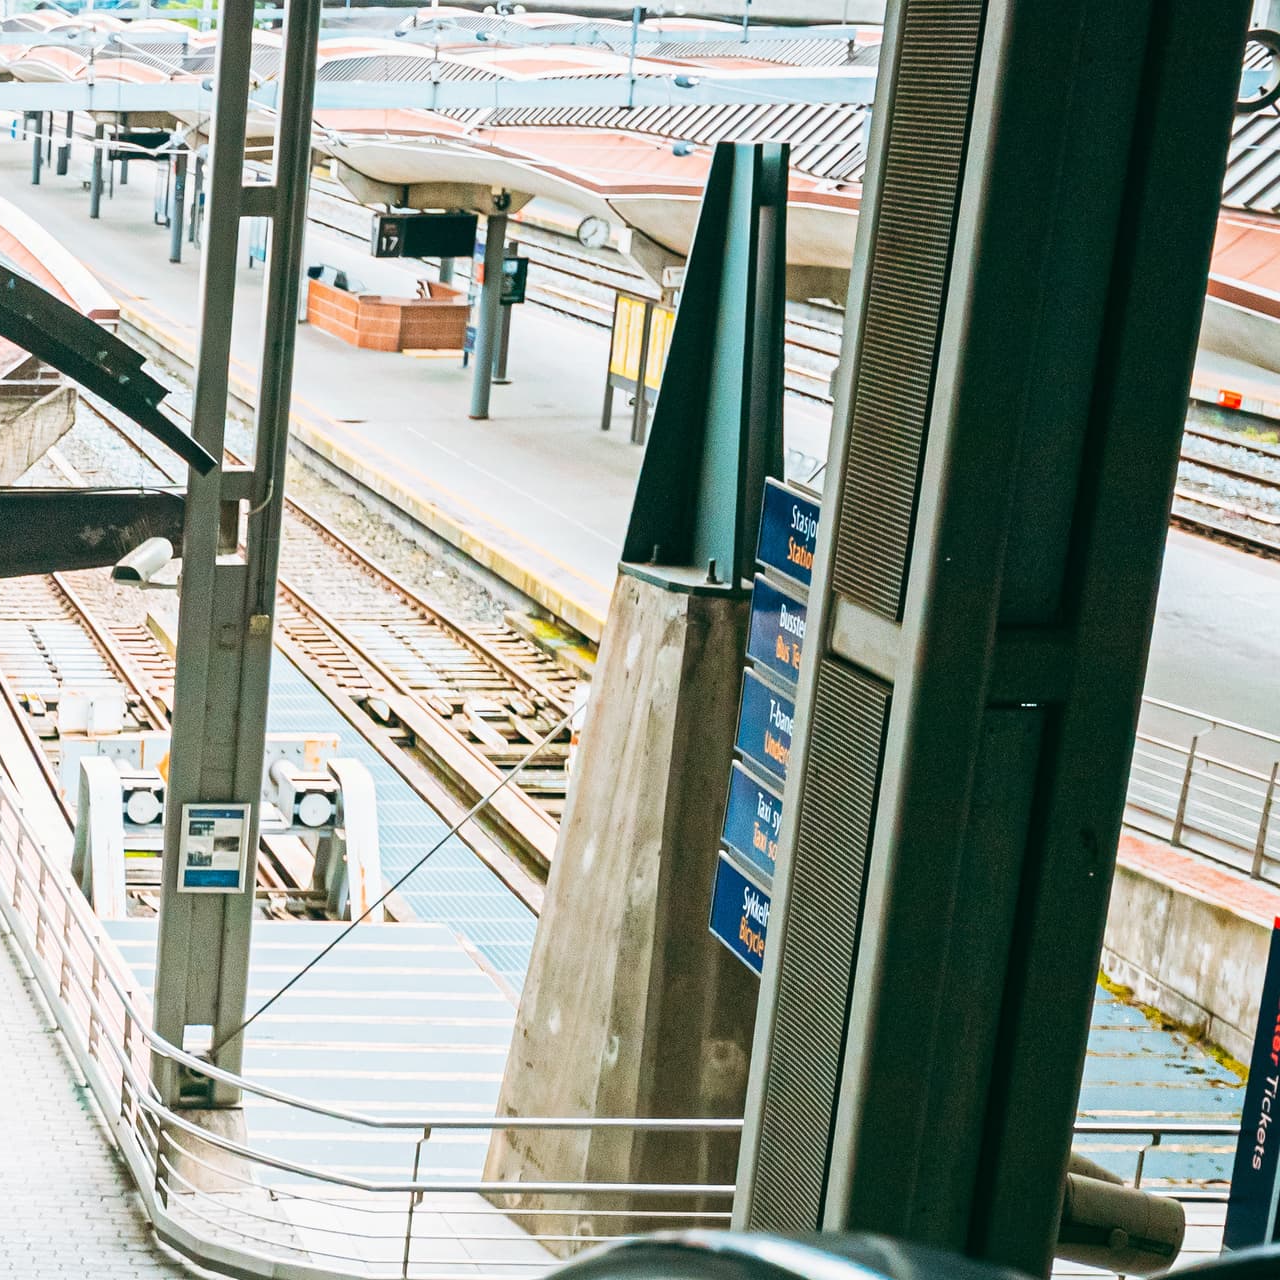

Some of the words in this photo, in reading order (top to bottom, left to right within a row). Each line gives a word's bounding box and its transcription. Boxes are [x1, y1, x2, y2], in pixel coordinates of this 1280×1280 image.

[382, 236, 399, 251] 17
[791, 504, 818, 541] Stasjo
[776, 635, 789, 663] Bus
[757, 792, 771, 823] Taxi
[772, 811, 782, 835] sy
[753, 822, 768, 852] Taxi
[740, 915, 765, 957] Bicycle
[1252, 1075, 1279, 1170] Tickets
